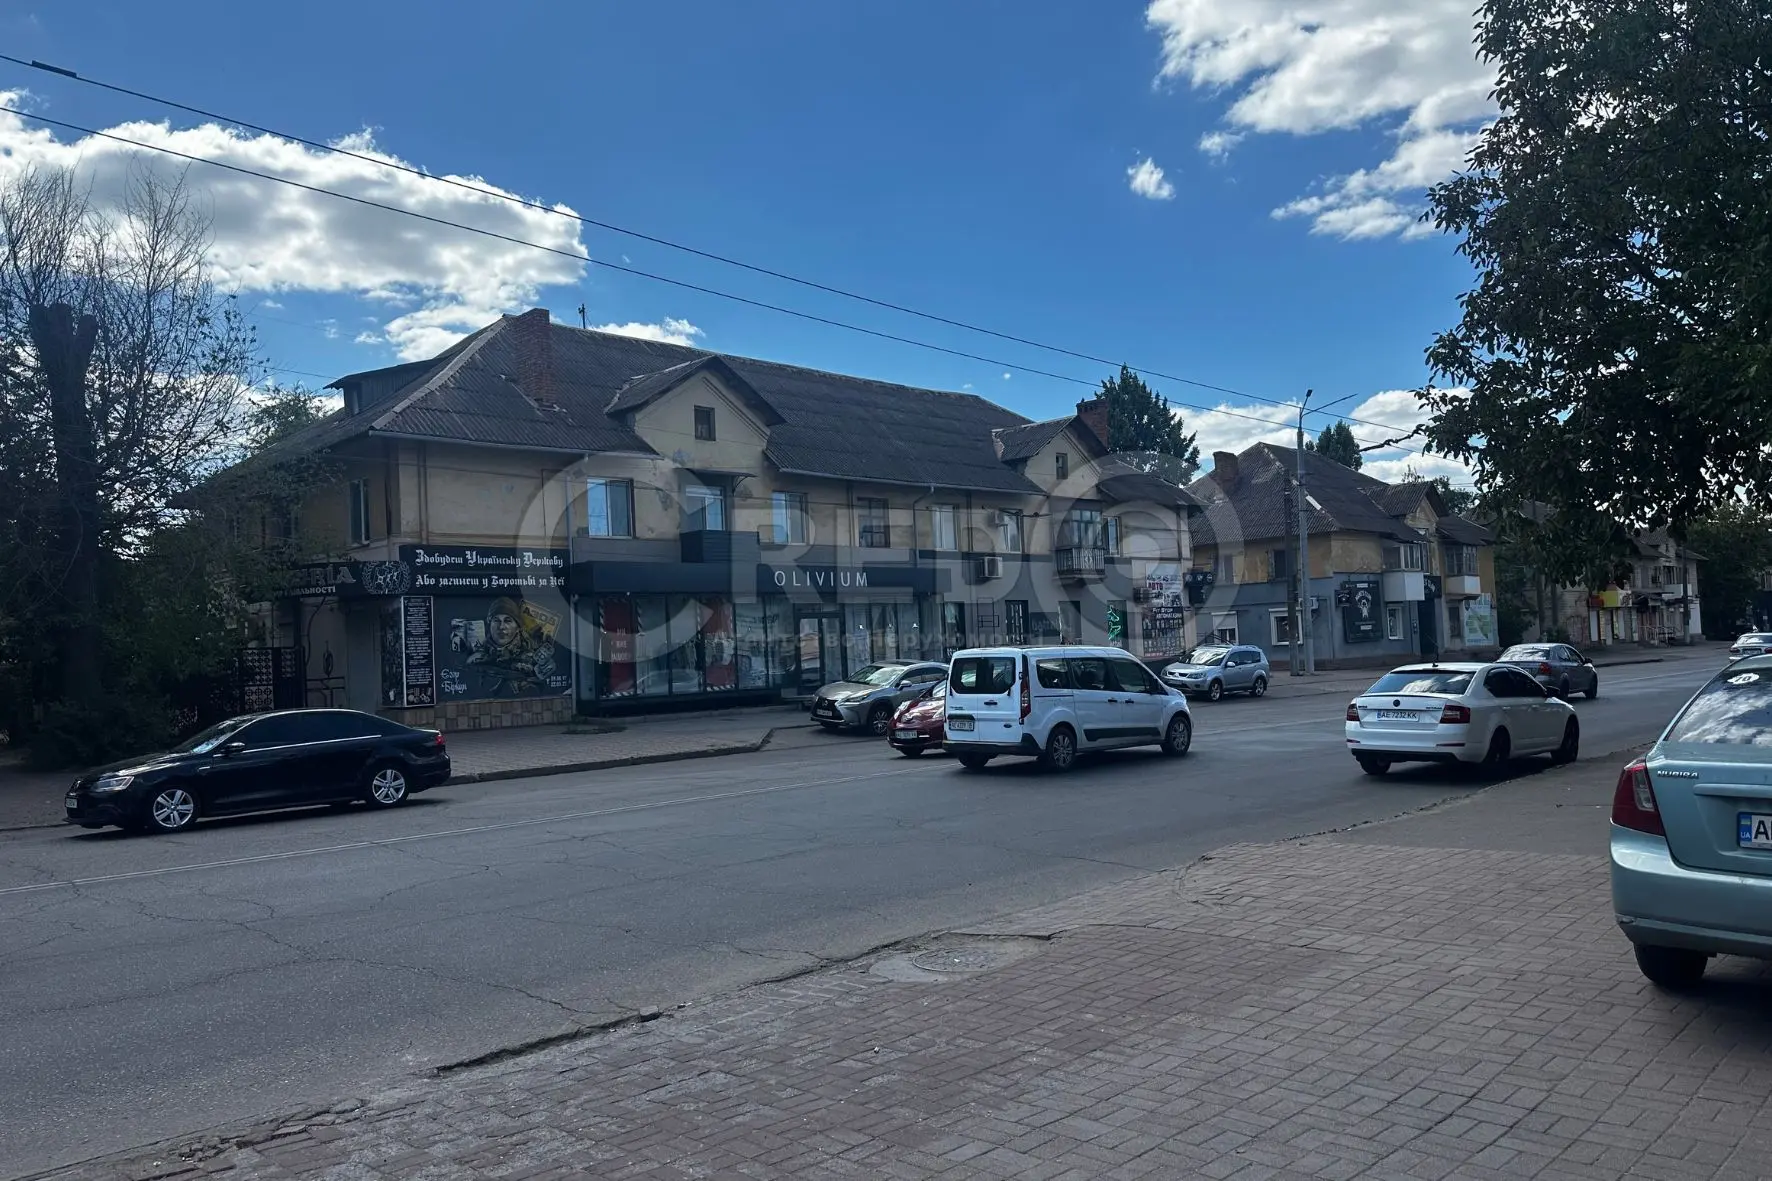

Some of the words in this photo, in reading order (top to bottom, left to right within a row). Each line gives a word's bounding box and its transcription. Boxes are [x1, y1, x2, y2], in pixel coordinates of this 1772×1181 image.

[465, 550, 521, 568] Українську
[523, 552, 564, 568] Державу
[415, 574, 436, 588] Або
[482, 578, 489, 589] у
[491, 575, 536, 588] Боротьбі
[539, 579, 548, 588] за
[774, 570, 869, 587] OLIVIUM
[1735, 675, 1752, 683] 70
[1381, 711, 1391, 719] AE
[1391, 711, 1407, 719] 7232
[1407, 711, 1417, 719] KK
[1657, 770, 1699, 779] NUBIRA
[1740, 831, 1752, 840] UA
[1753, 819, 1772, 841] A
